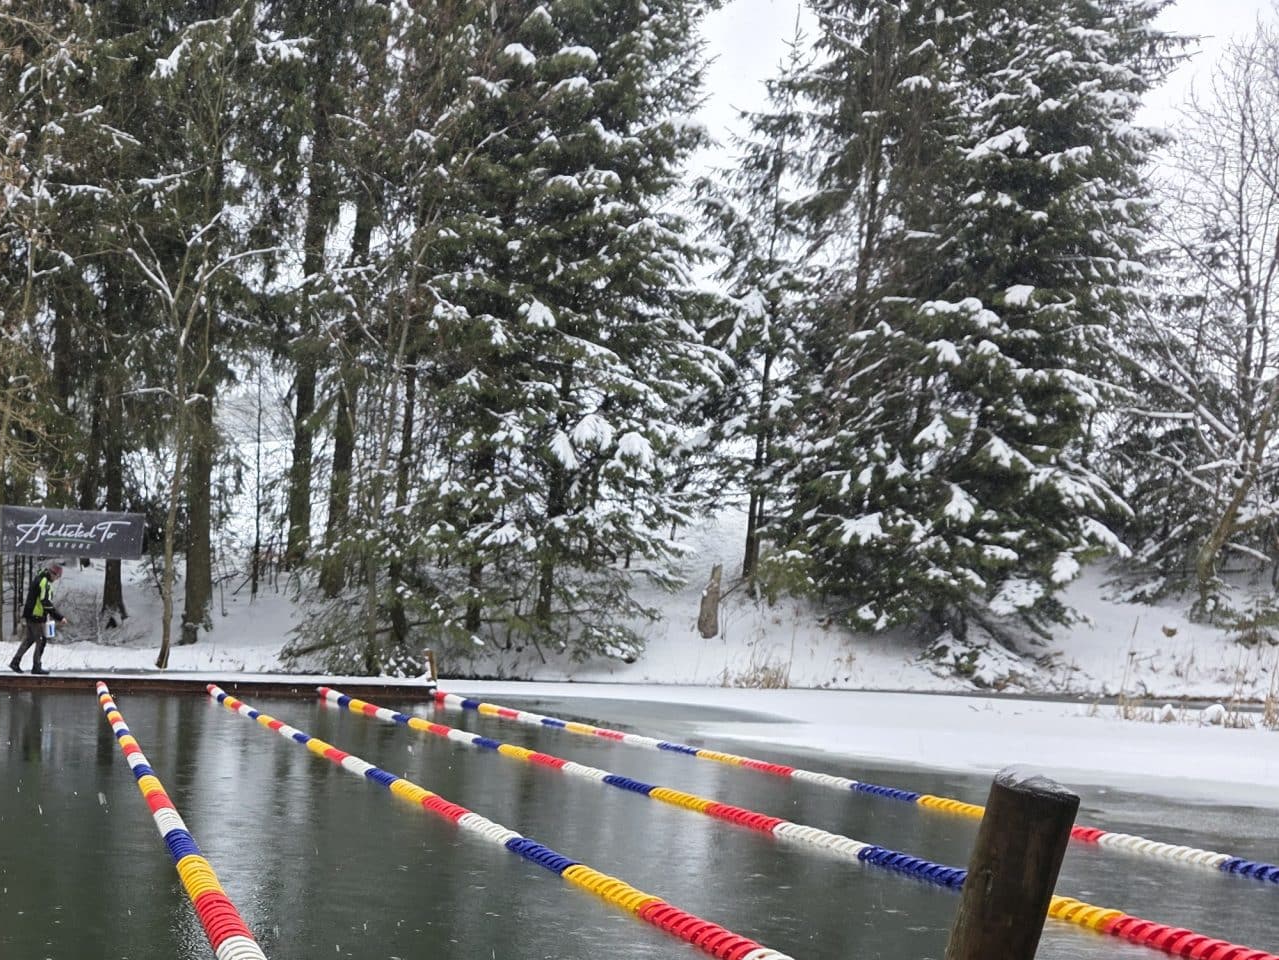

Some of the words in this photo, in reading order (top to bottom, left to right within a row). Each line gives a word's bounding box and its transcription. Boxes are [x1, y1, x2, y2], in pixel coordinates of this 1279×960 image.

[16, 514, 96, 547] Addicted
[96, 521, 131, 543] To
[48, 541, 91, 549] NATURE
